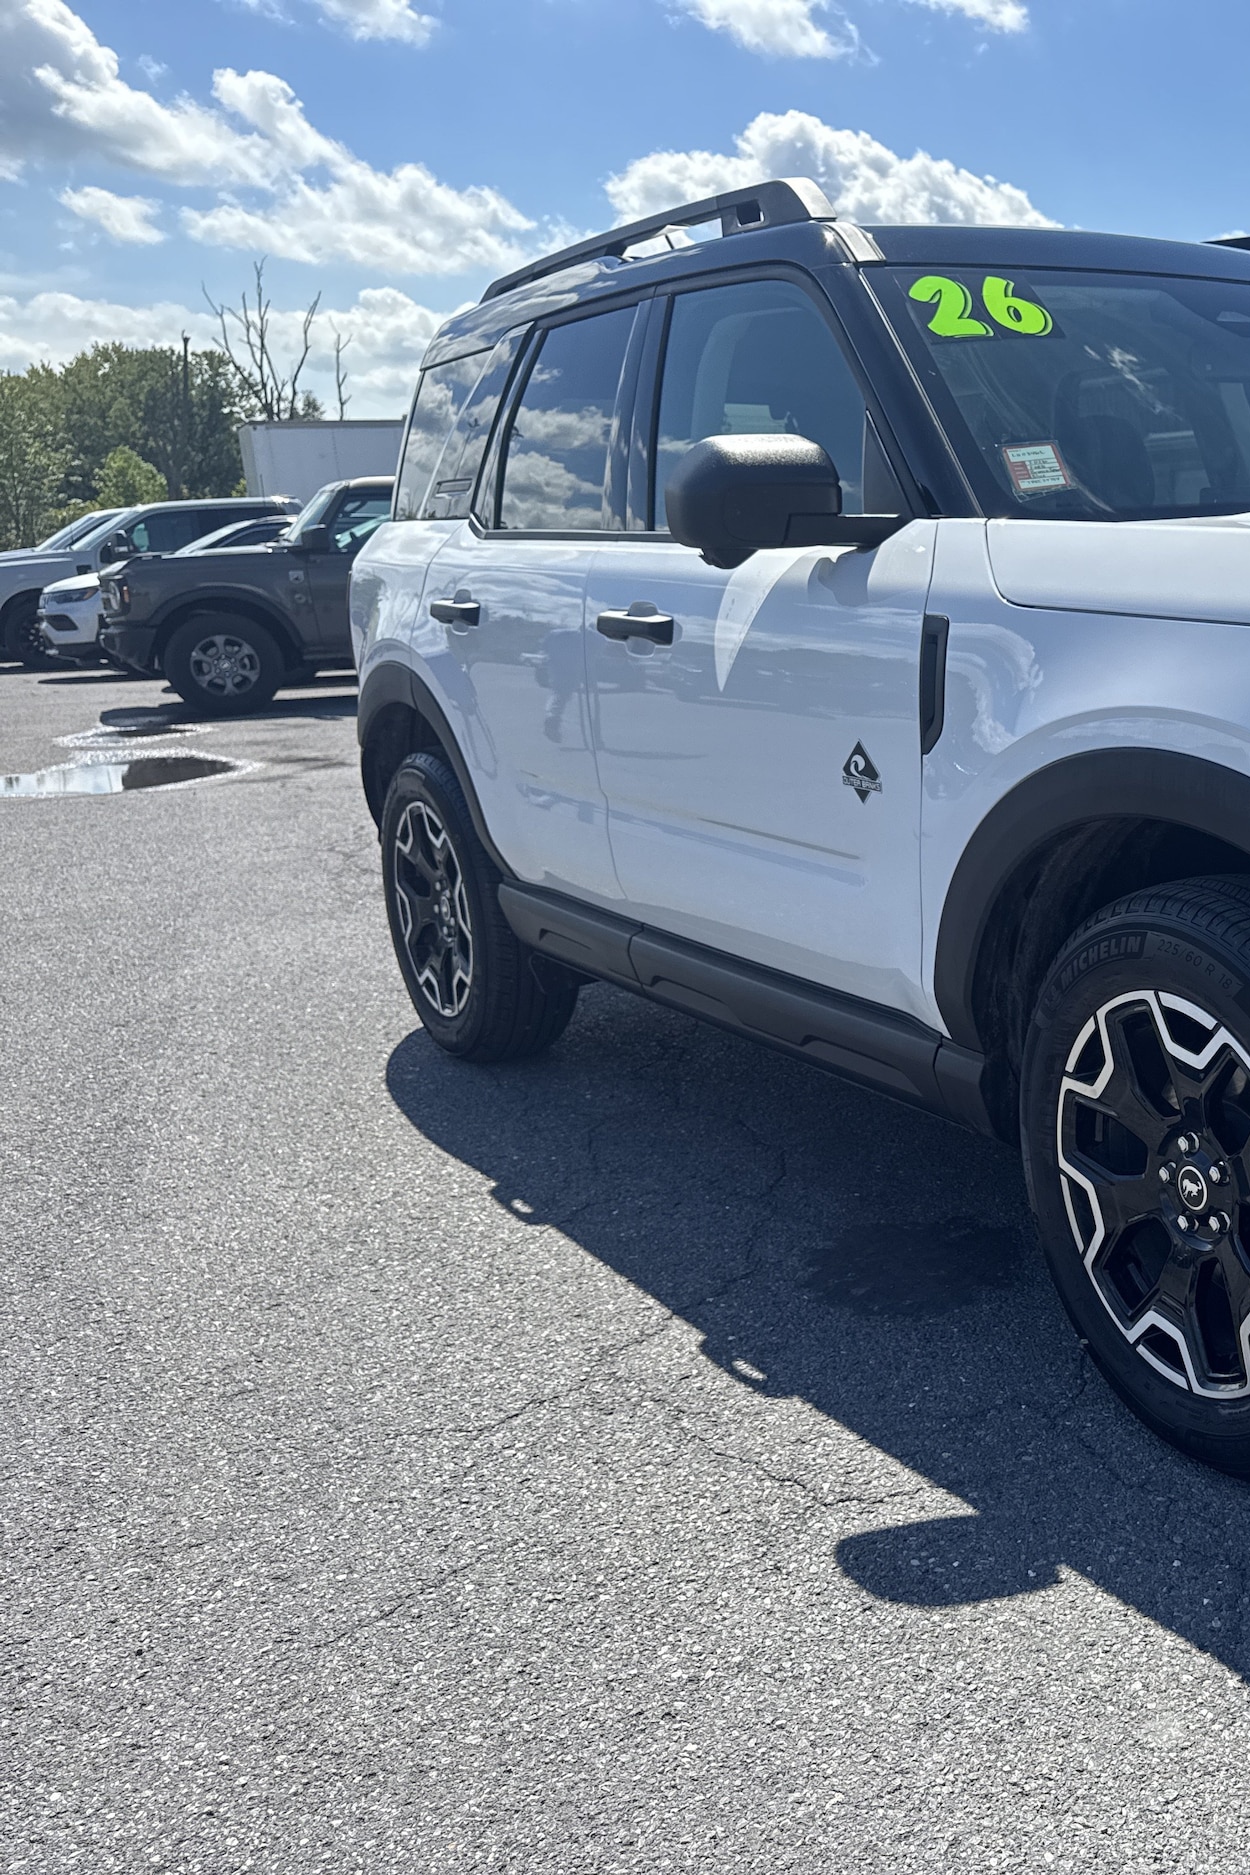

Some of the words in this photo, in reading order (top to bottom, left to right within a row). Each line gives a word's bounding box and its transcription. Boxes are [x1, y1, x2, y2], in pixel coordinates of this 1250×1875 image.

[843, 776, 861, 787] OUTER
[861, 780, 880, 791] BANKS
[1060, 936, 1141, 991] MICHELIN
[1157, 938, 1203, 968] 225/60
[1204, 964, 1216, 977] R
[1219, 973, 1234, 990] 18
